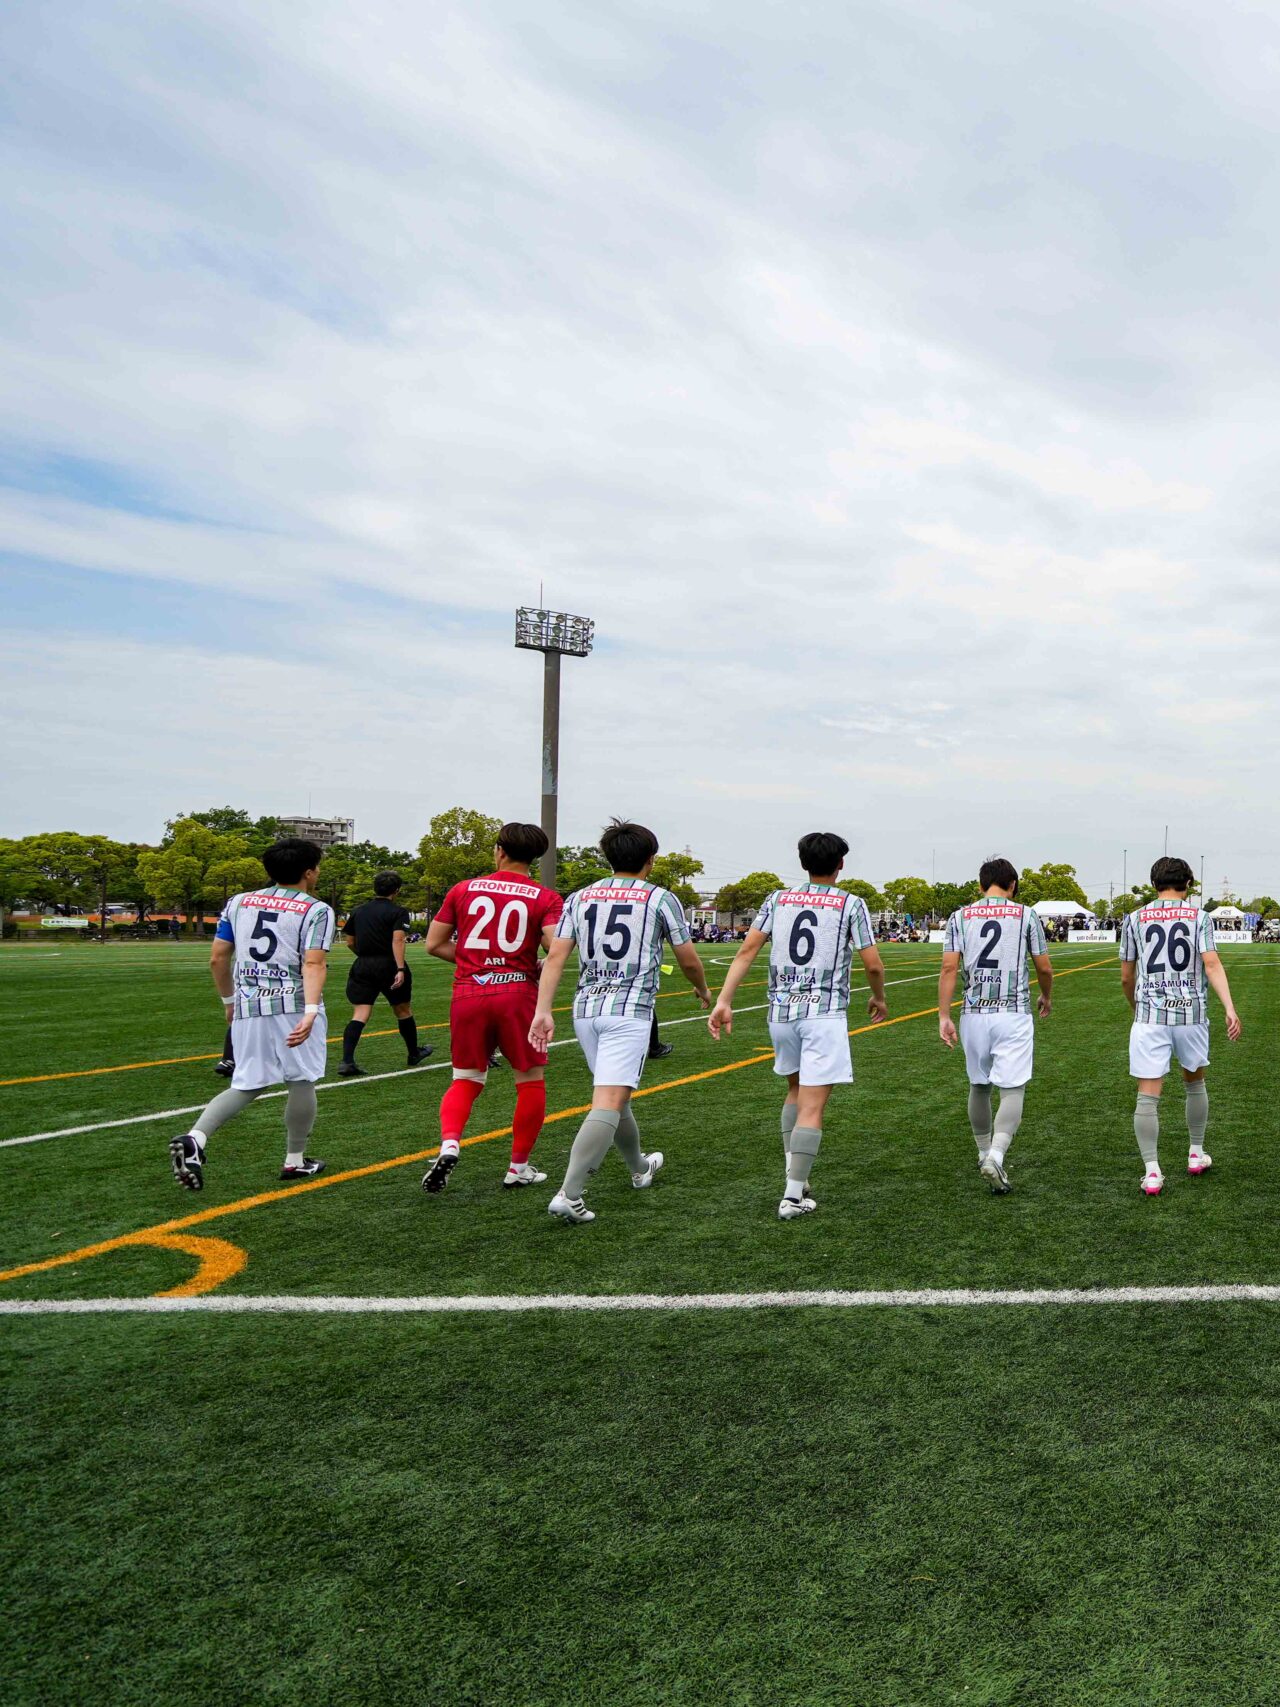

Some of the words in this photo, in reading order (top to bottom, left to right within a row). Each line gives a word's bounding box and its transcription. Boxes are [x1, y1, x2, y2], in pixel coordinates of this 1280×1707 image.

[471, 881, 536, 897] FRONTIER
[582, 889, 646, 900] FRONTIER
[243, 896, 307, 912] FRONTIER
[780, 894, 842, 906] FRONTIER
[965, 907, 1020, 917] FRONTIER
[1140, 909, 1195, 919] FRONTIER
[464, 896, 528, 952] 20
[249, 911, 279, 962] 5
[584, 904, 633, 960] 15
[789, 910, 818, 966] 6
[977, 920, 1002, 968] 2
[1146, 922, 1190, 974] 26
[484, 958, 506, 966] ARI
[240, 968, 288, 978] HINENO
[780, 974, 816, 984] SHUYA
[1142, 980, 1196, 989] MASAMUNE
